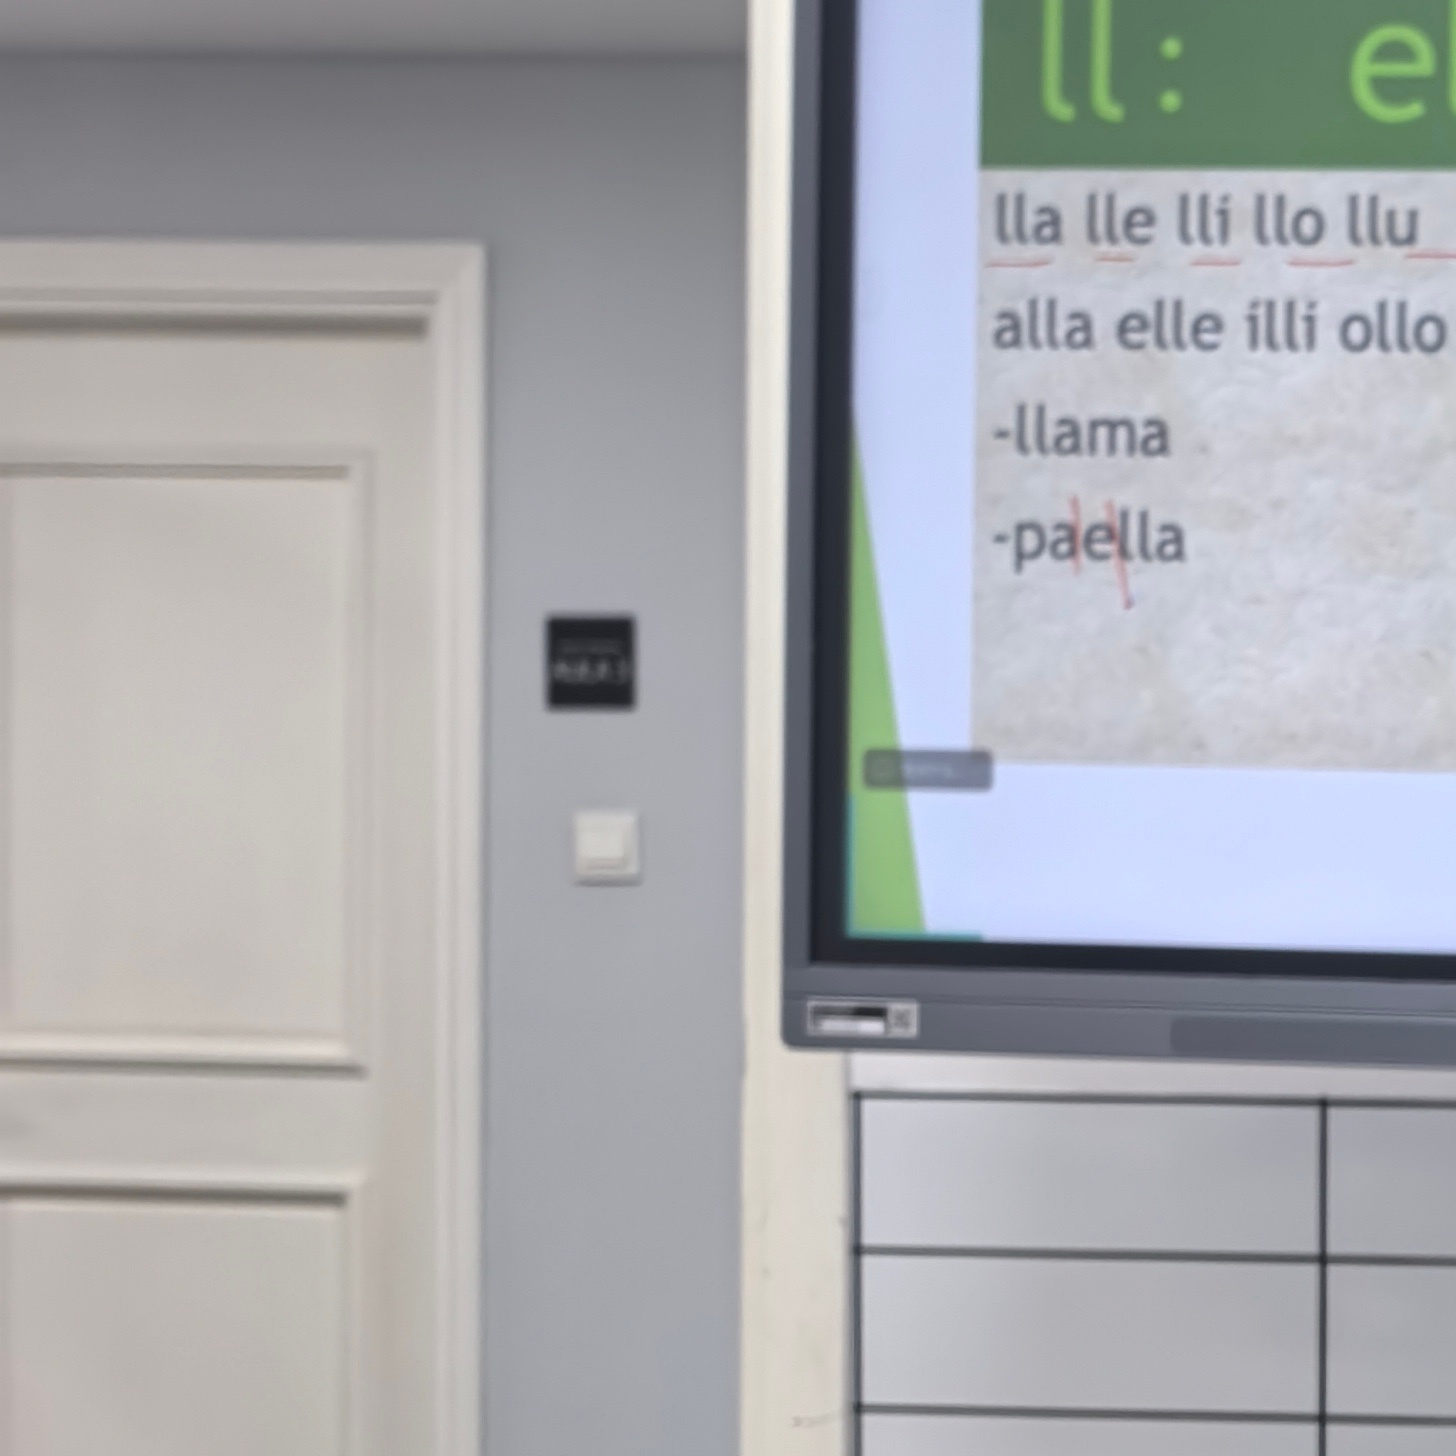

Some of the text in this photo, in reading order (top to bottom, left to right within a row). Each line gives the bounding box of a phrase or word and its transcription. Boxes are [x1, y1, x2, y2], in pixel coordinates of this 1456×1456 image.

[994, 192, 1420, 247] lla lle lli llo llu
[991, 297, 1094, 351] alla
[1115, 298, 1225, 352] elle
[1245, 299, 1318, 353] illi
[1338, 300, 1448, 355] ollo
[993, 403, 1171, 458] -llama
[993, 508, 1187, 573] -paella
